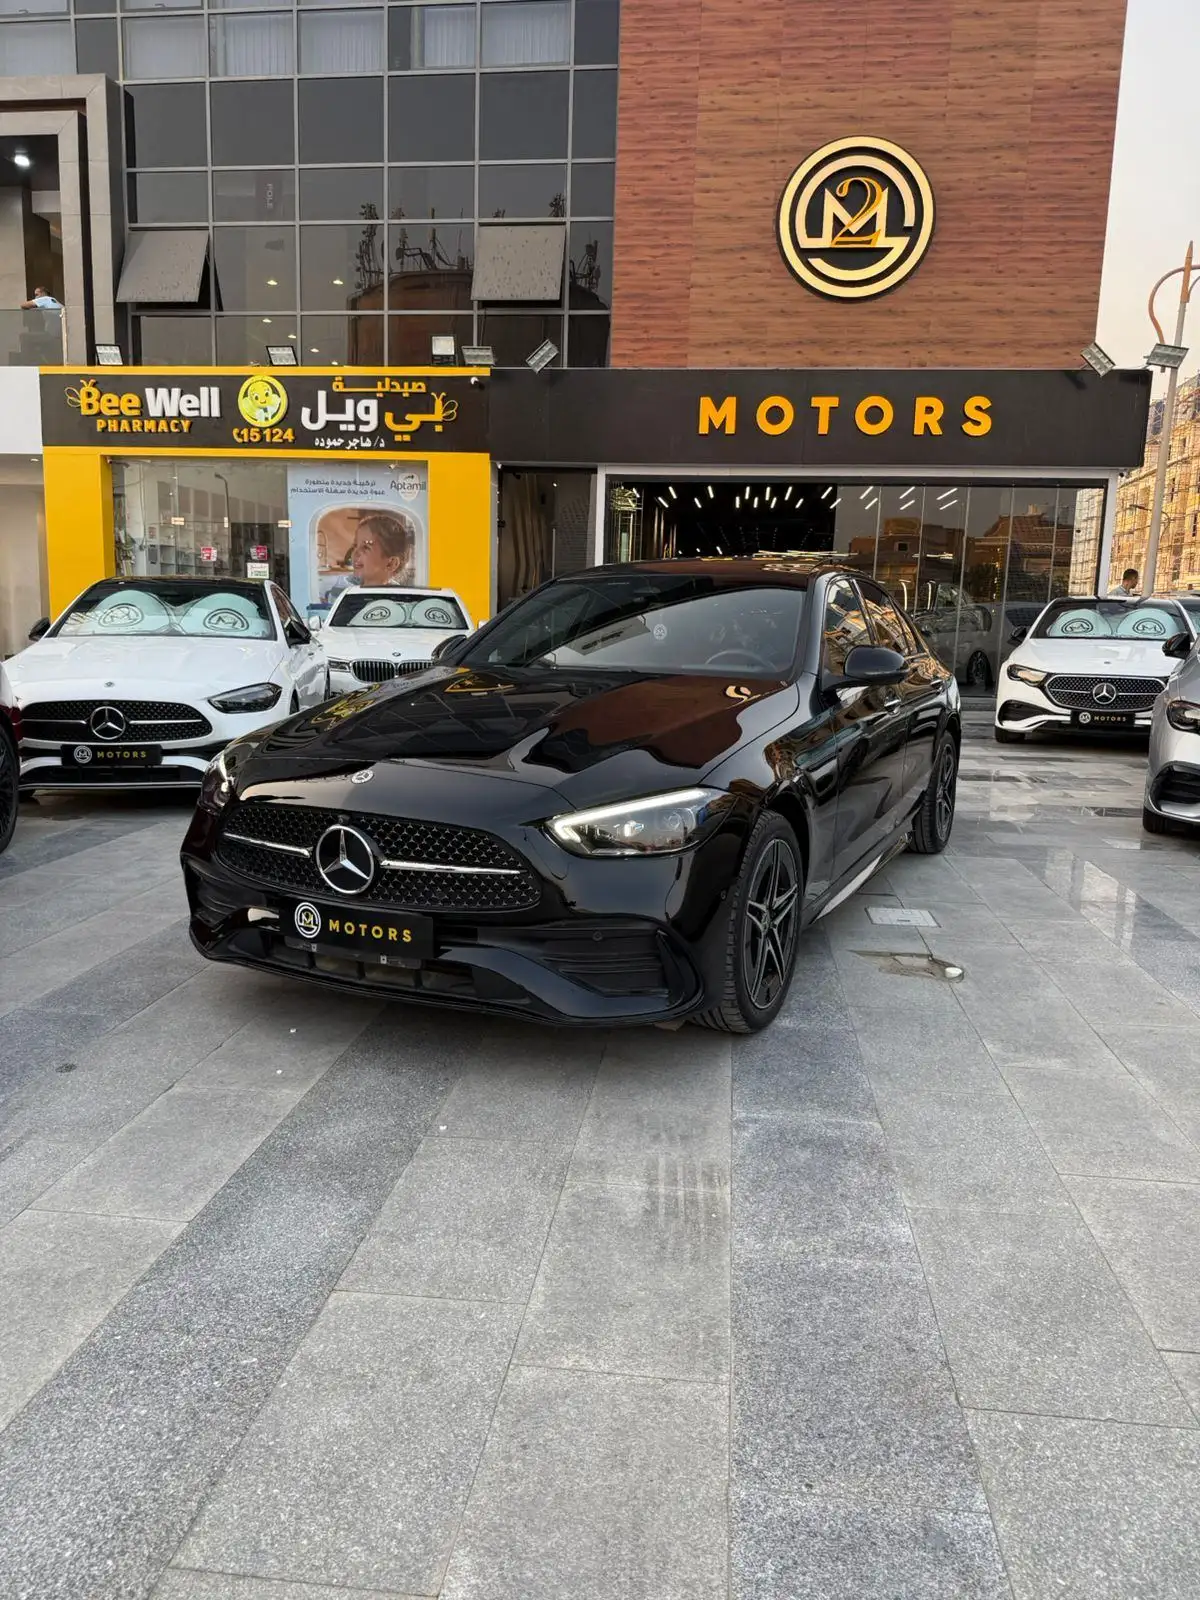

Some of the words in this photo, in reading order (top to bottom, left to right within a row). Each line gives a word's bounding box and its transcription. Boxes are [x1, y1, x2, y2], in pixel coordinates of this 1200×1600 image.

[79, 379, 142, 416] Bee
[144, 387, 221, 417] Well
[301, 390, 379, 432] ويل
[97, 419, 193, 433] PHARMACY
[384, 392, 445, 442] بي
[698, 395, 992, 437] MOTORS
[390, 480, 427, 491] Aptamil
[97, 750, 147, 758] MOTORS
[328, 918, 413, 943] MOTORS
